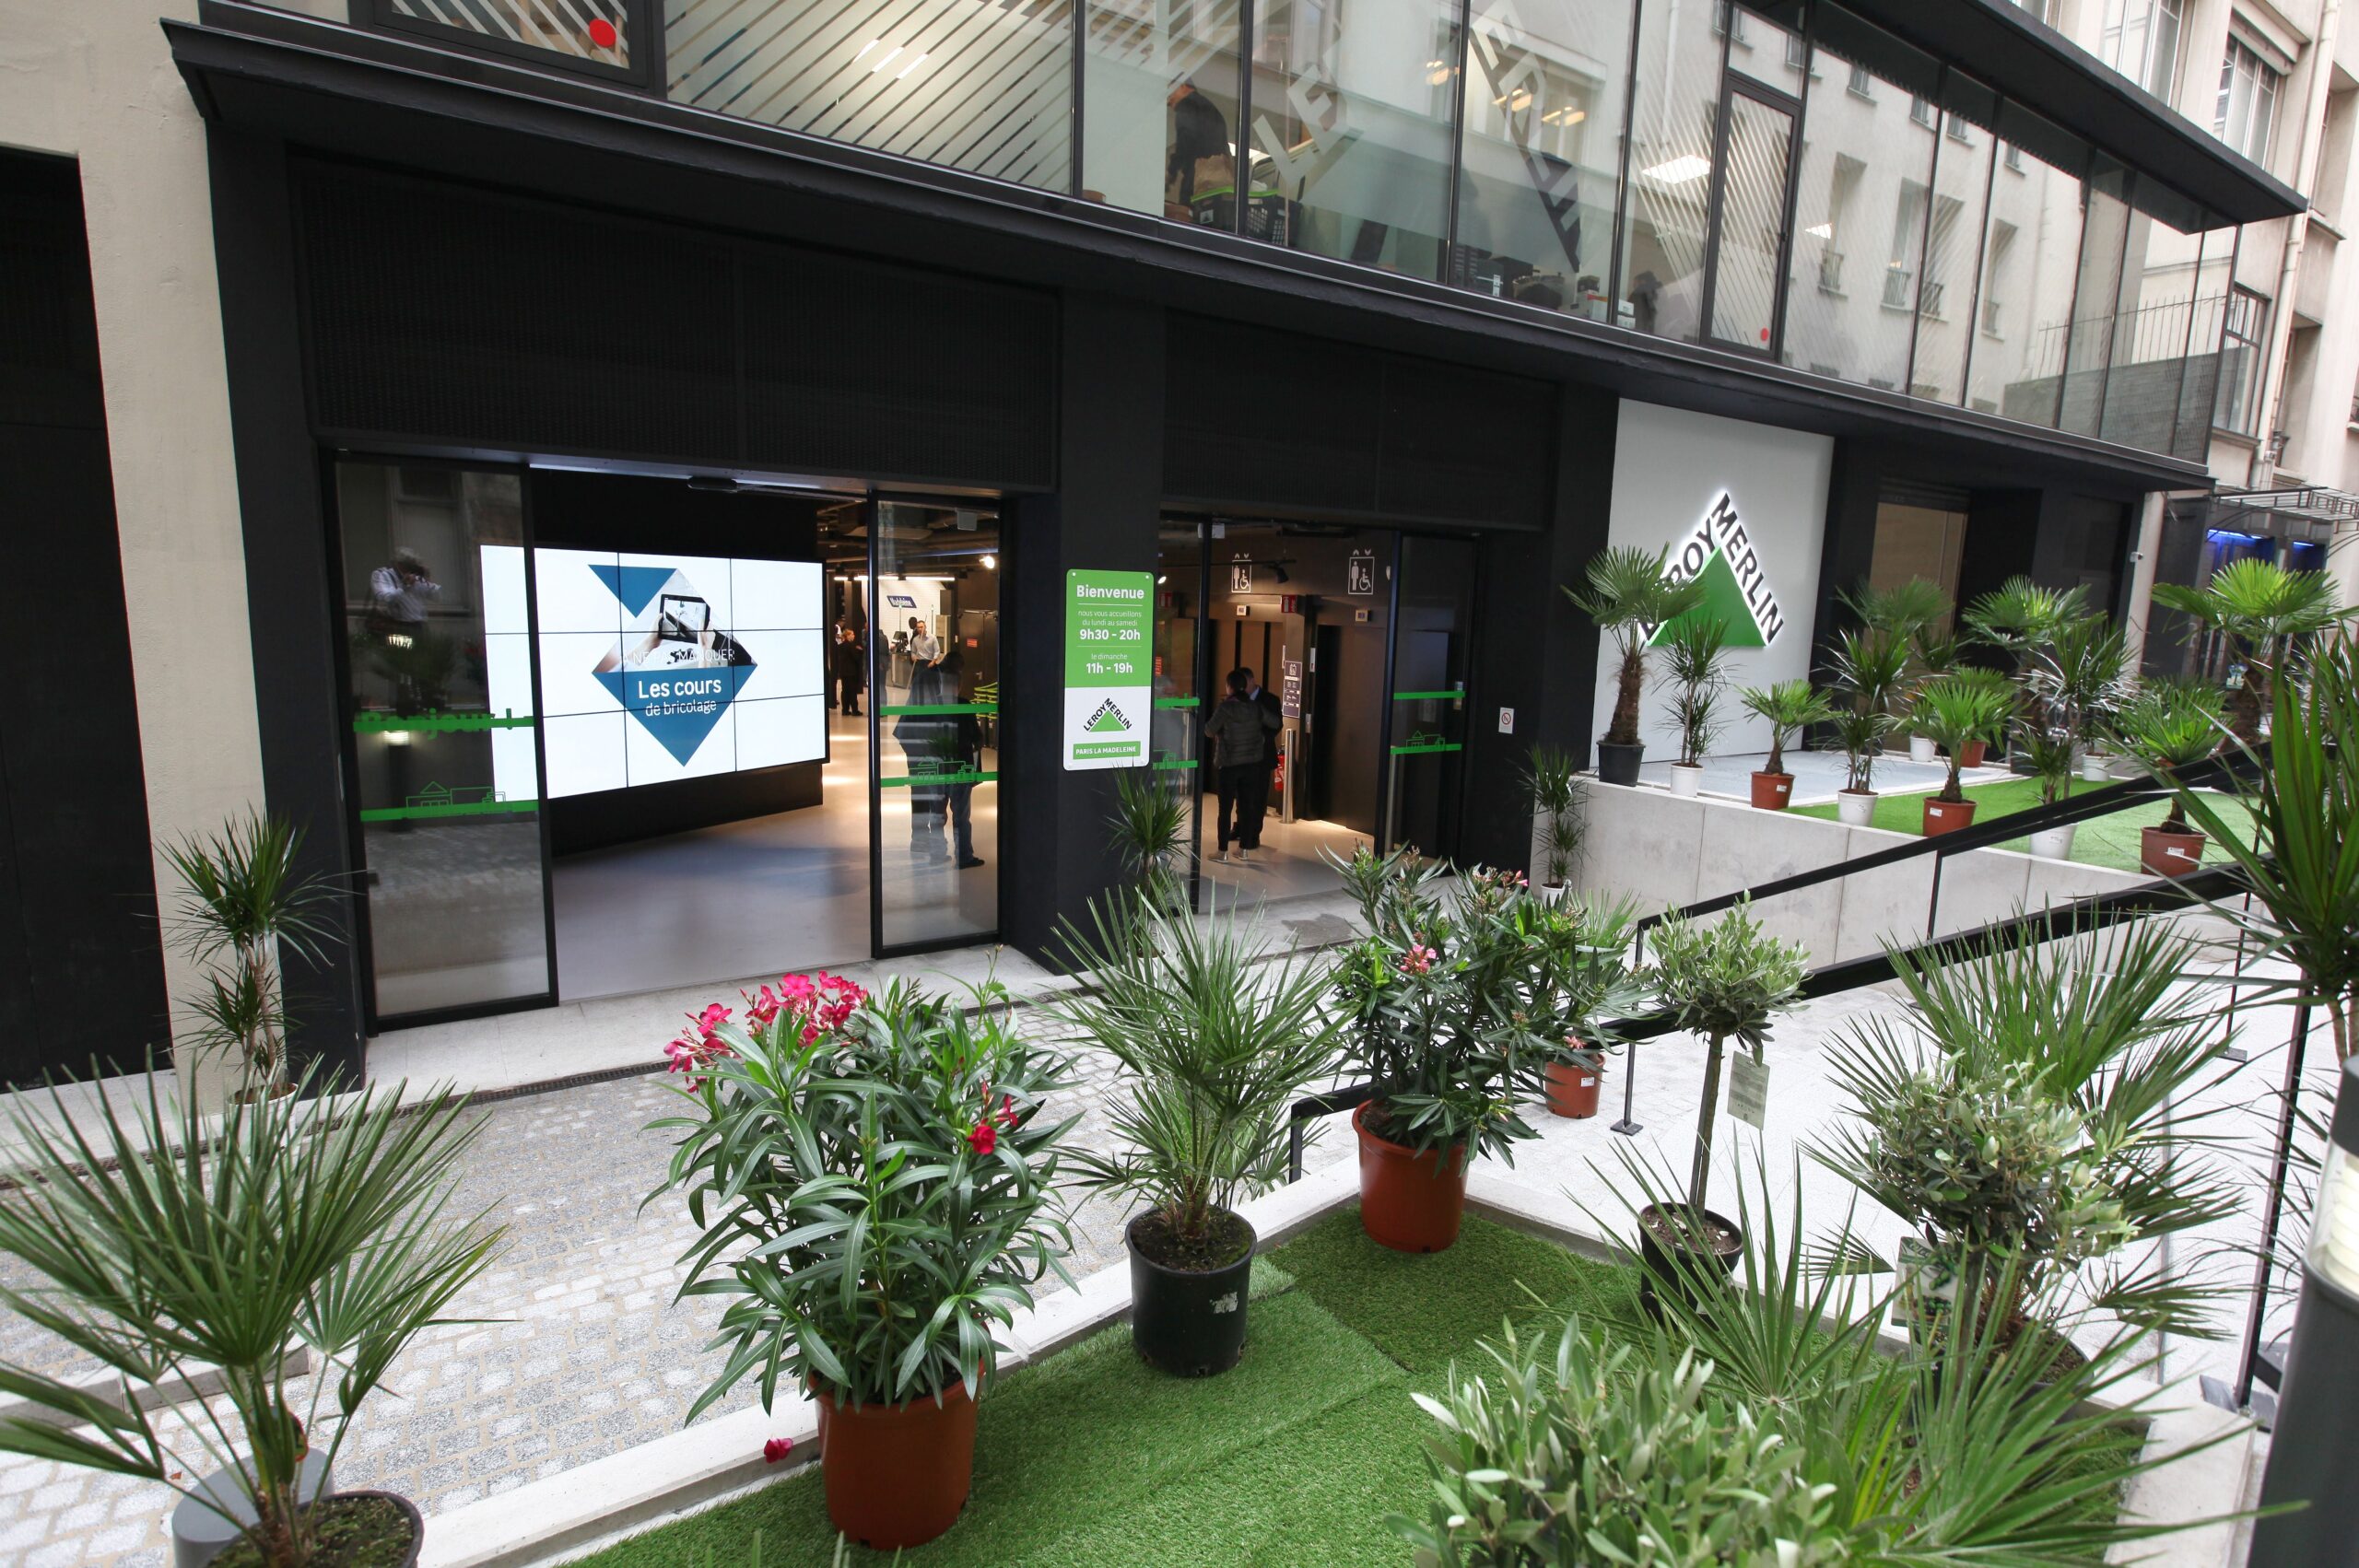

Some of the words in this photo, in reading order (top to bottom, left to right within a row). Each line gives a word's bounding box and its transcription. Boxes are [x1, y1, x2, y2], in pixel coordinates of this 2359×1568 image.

[1711, 492, 1785, 645] MERLIN
[1638, 519, 1716, 642] LOY
[1076, 583, 1144, 600] Bienvenue
[1079, 628, 1109, 640] 9h30
[1119, 628, 1141, 640] 20h
[1086, 662, 1104, 673] 11h
[1113, 661, 1133, 673] 19h
[638, 680, 670, 699] Les
[674, 678, 722, 696] cours
[645, 702, 661, 717] de
[663, 698, 717, 716] bricolage
[1083, 704, 1107, 731] LEROY
[1104, 697, 1133, 731] MERLIN
[1103, 745, 1136, 754] MADELEINE
